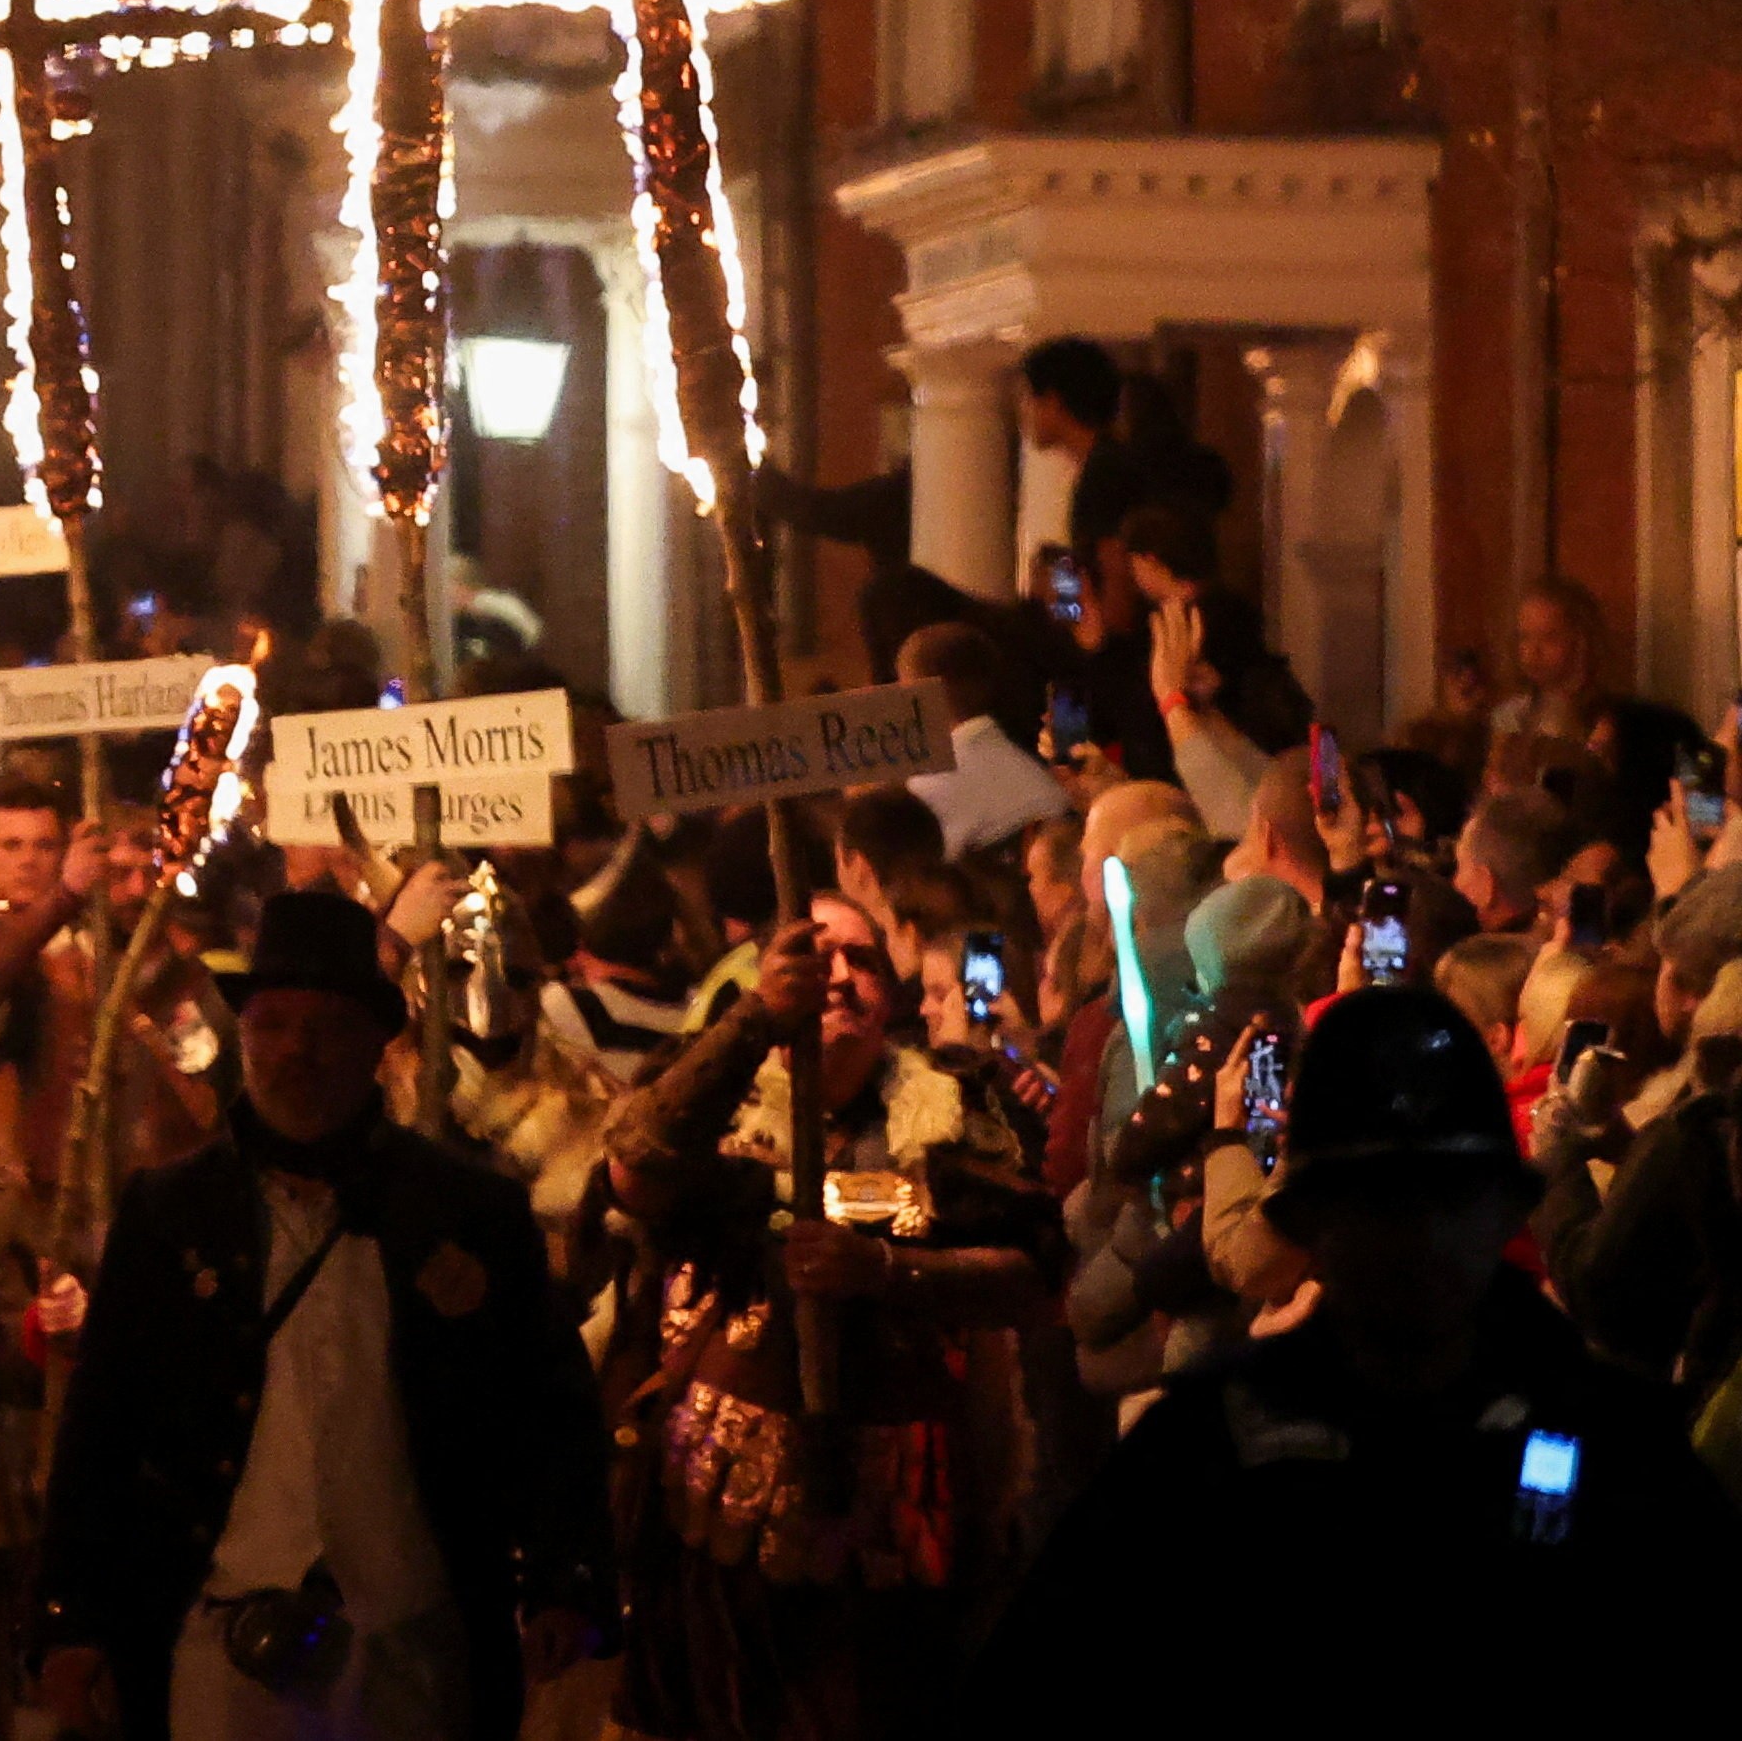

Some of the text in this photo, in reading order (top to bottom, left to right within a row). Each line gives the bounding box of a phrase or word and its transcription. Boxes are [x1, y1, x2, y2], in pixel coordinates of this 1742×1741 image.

[303, 705, 546, 780] James Morris
[633, 730, 810, 799] Thomas
[439, 790, 524, 835] urges
